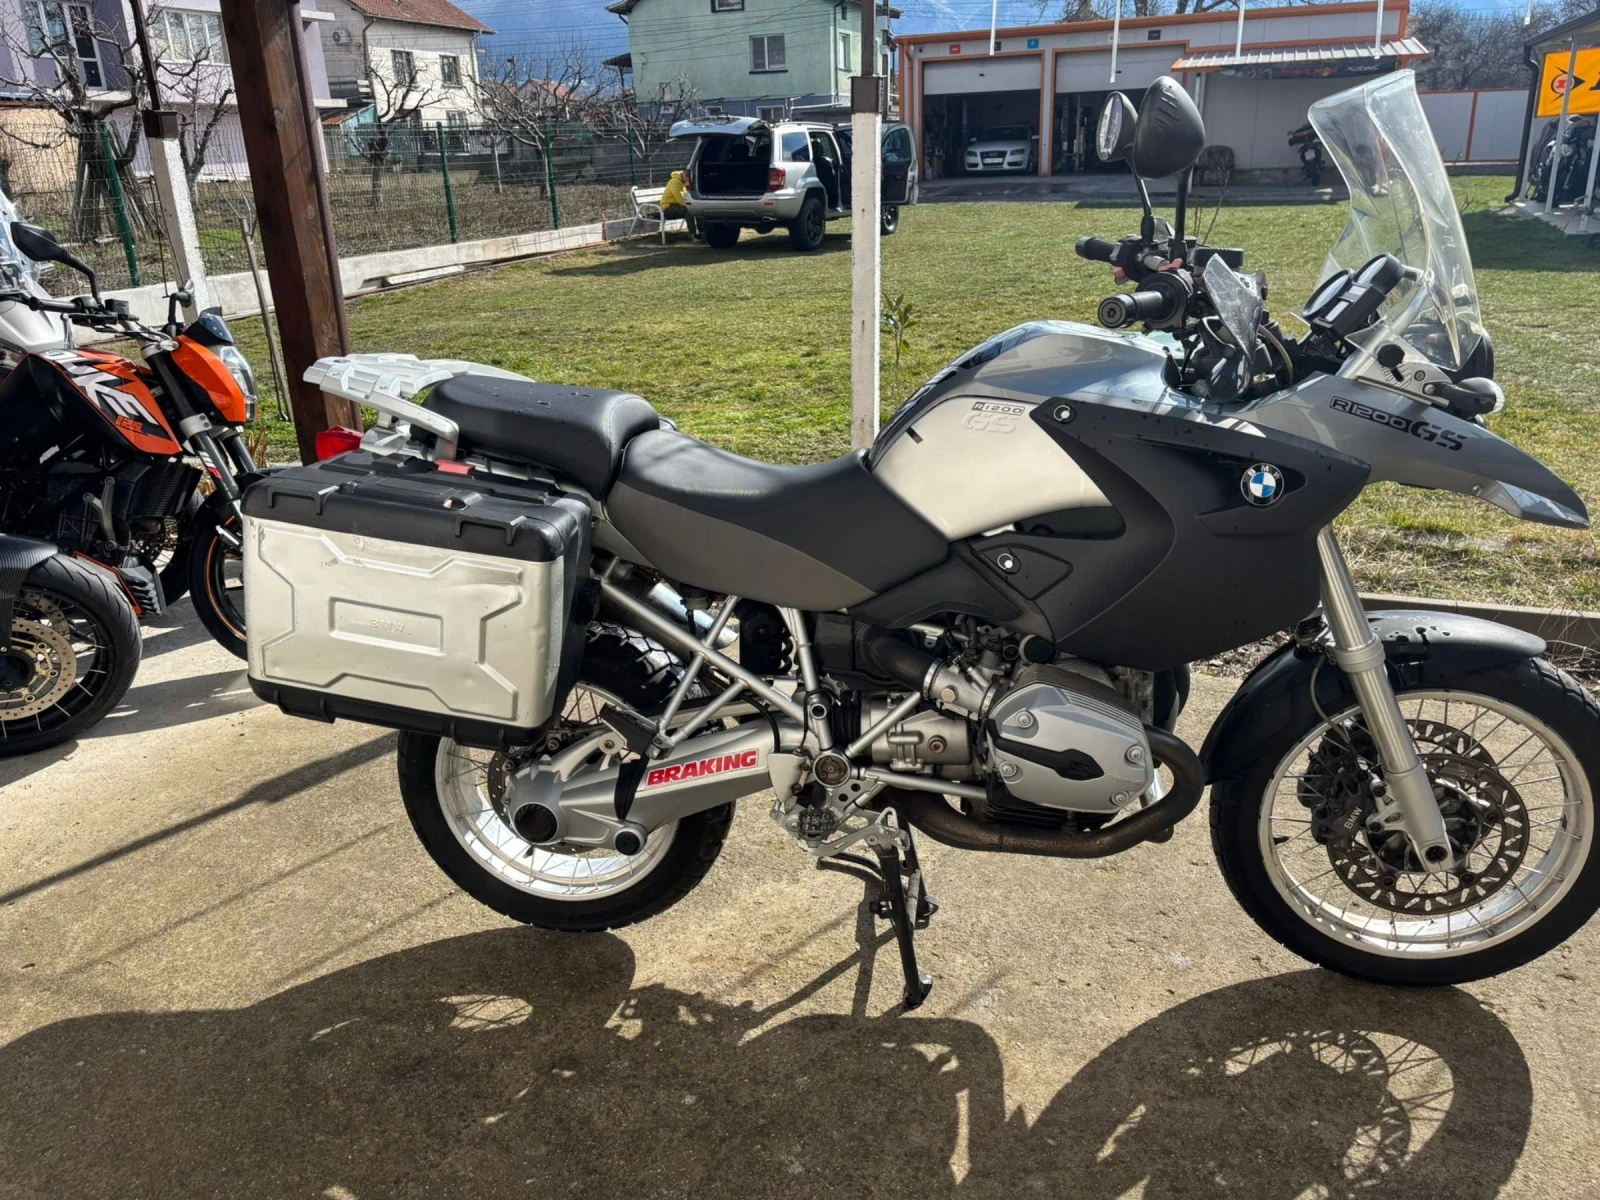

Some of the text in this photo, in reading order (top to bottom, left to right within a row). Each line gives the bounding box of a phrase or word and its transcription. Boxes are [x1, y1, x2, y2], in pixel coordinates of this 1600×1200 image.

[963, 412, 1020, 434] GS
[1247, 465, 1281, 479] BMW
[647, 750, 757, 786] BRAKING
[1343, 806, 1363, 829] BMW
